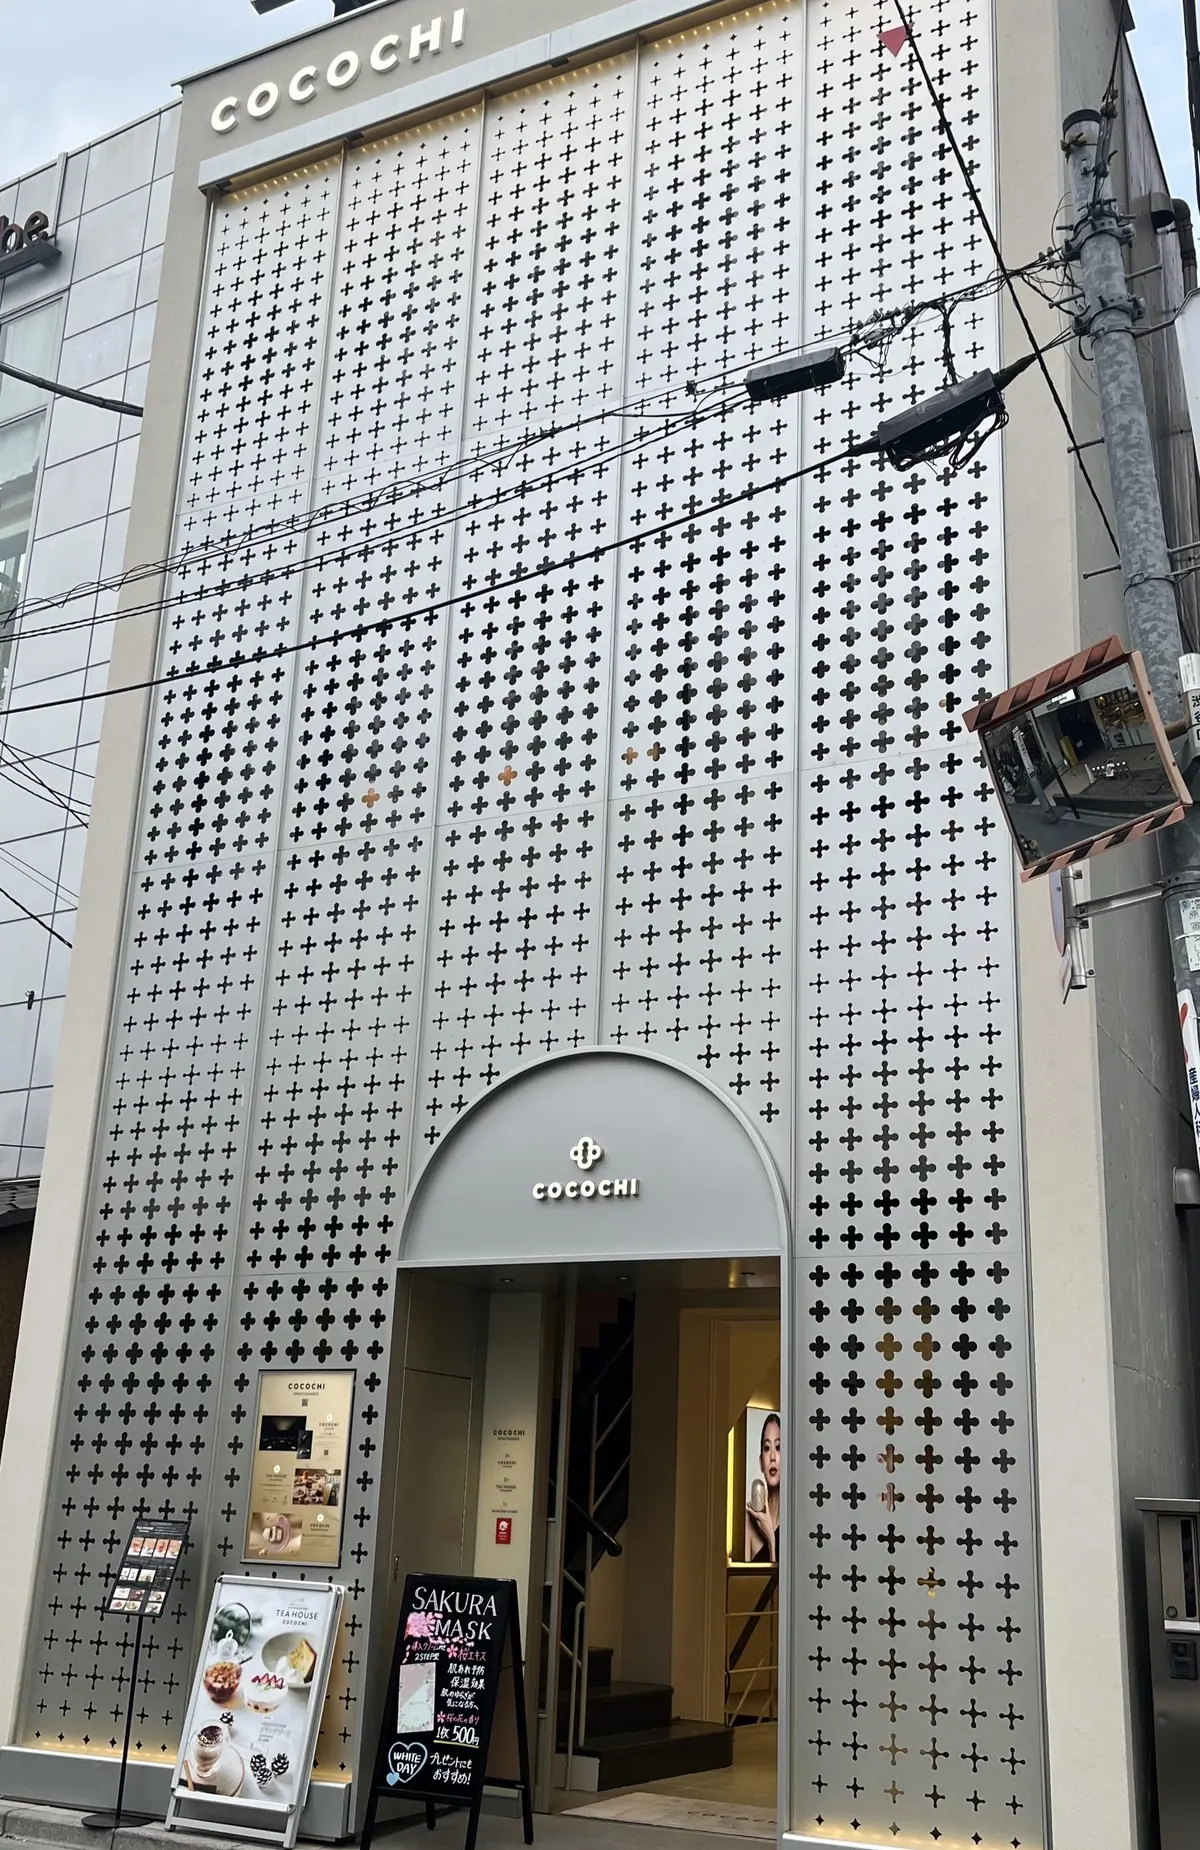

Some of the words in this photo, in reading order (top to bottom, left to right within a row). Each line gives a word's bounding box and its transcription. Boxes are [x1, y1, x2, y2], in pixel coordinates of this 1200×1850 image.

[211, 8, 465, 133] COCOCHI
[532, 1178, 640, 1200] COCOCHI
[412, 1586, 497, 1617] SAKURA
[276, 1609, 290, 1617] TEA
[291, 1611, 318, 1620] HOUSE
[434, 1619, 492, 1640] MASK
[447, 1663, 485, 1676] 肌あれ予防
[450, 1676, 485, 1690] 保湿効果
[446, 1698, 479, 1710] 気になる方へ
[451, 1725, 480, 1746] 500円
[393, 1752, 422, 1763] WHITE
[430, 1752, 473, 1769] プレゼントにも
[396, 1762, 417, 1775] DAY
